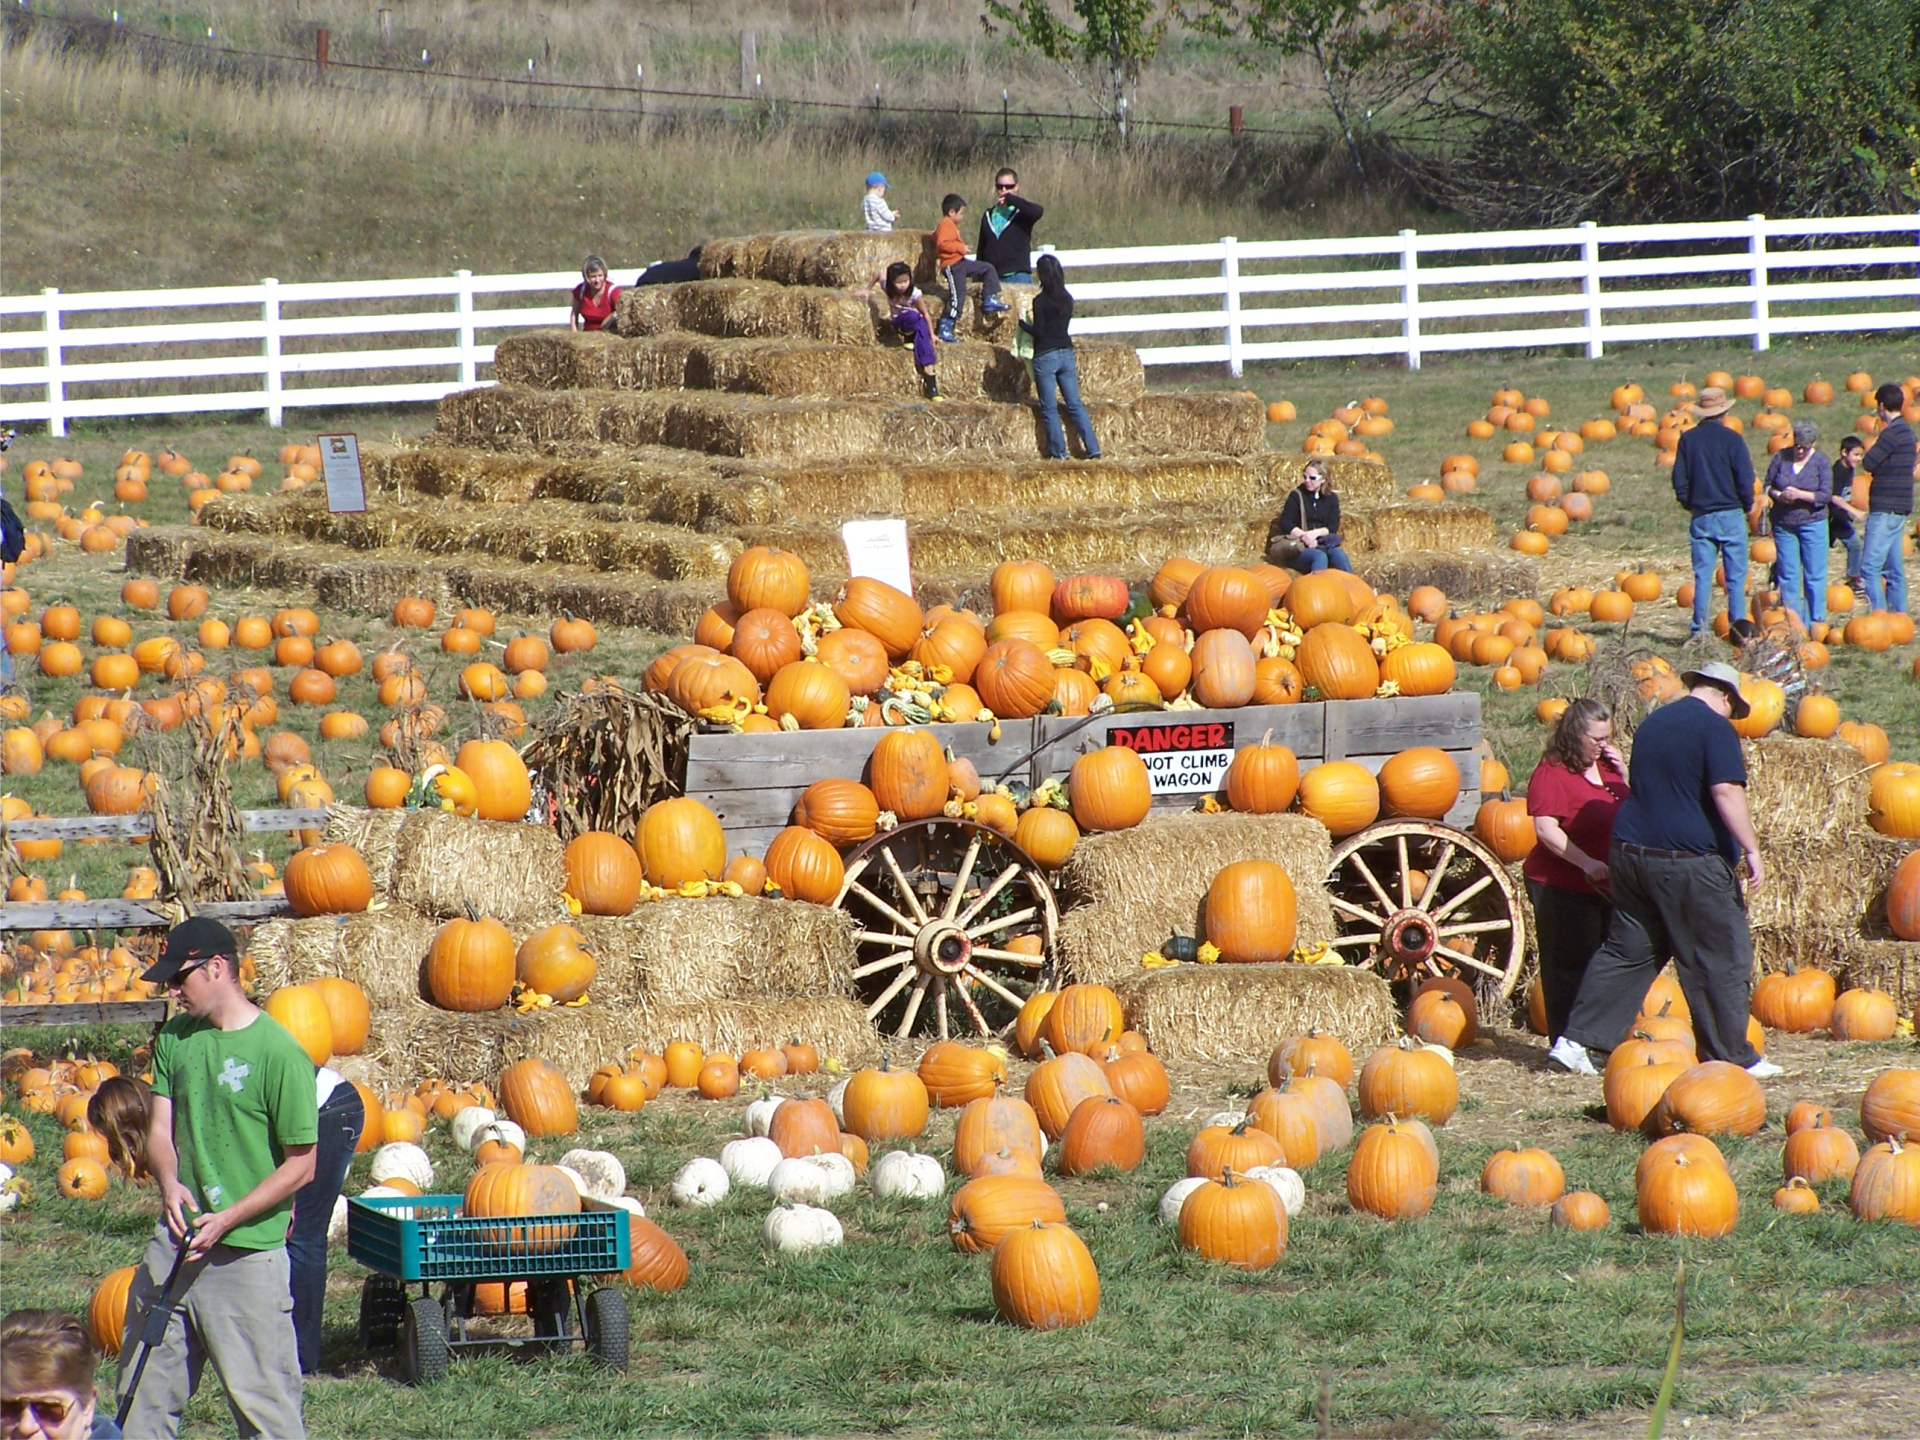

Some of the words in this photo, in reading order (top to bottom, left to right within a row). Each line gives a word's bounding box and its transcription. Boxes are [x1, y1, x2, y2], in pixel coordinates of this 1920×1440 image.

[1114, 723, 1225, 751] DANGER
[1181, 753, 1228, 769] CLIMB
[1154, 771, 1212, 788] WAGON
